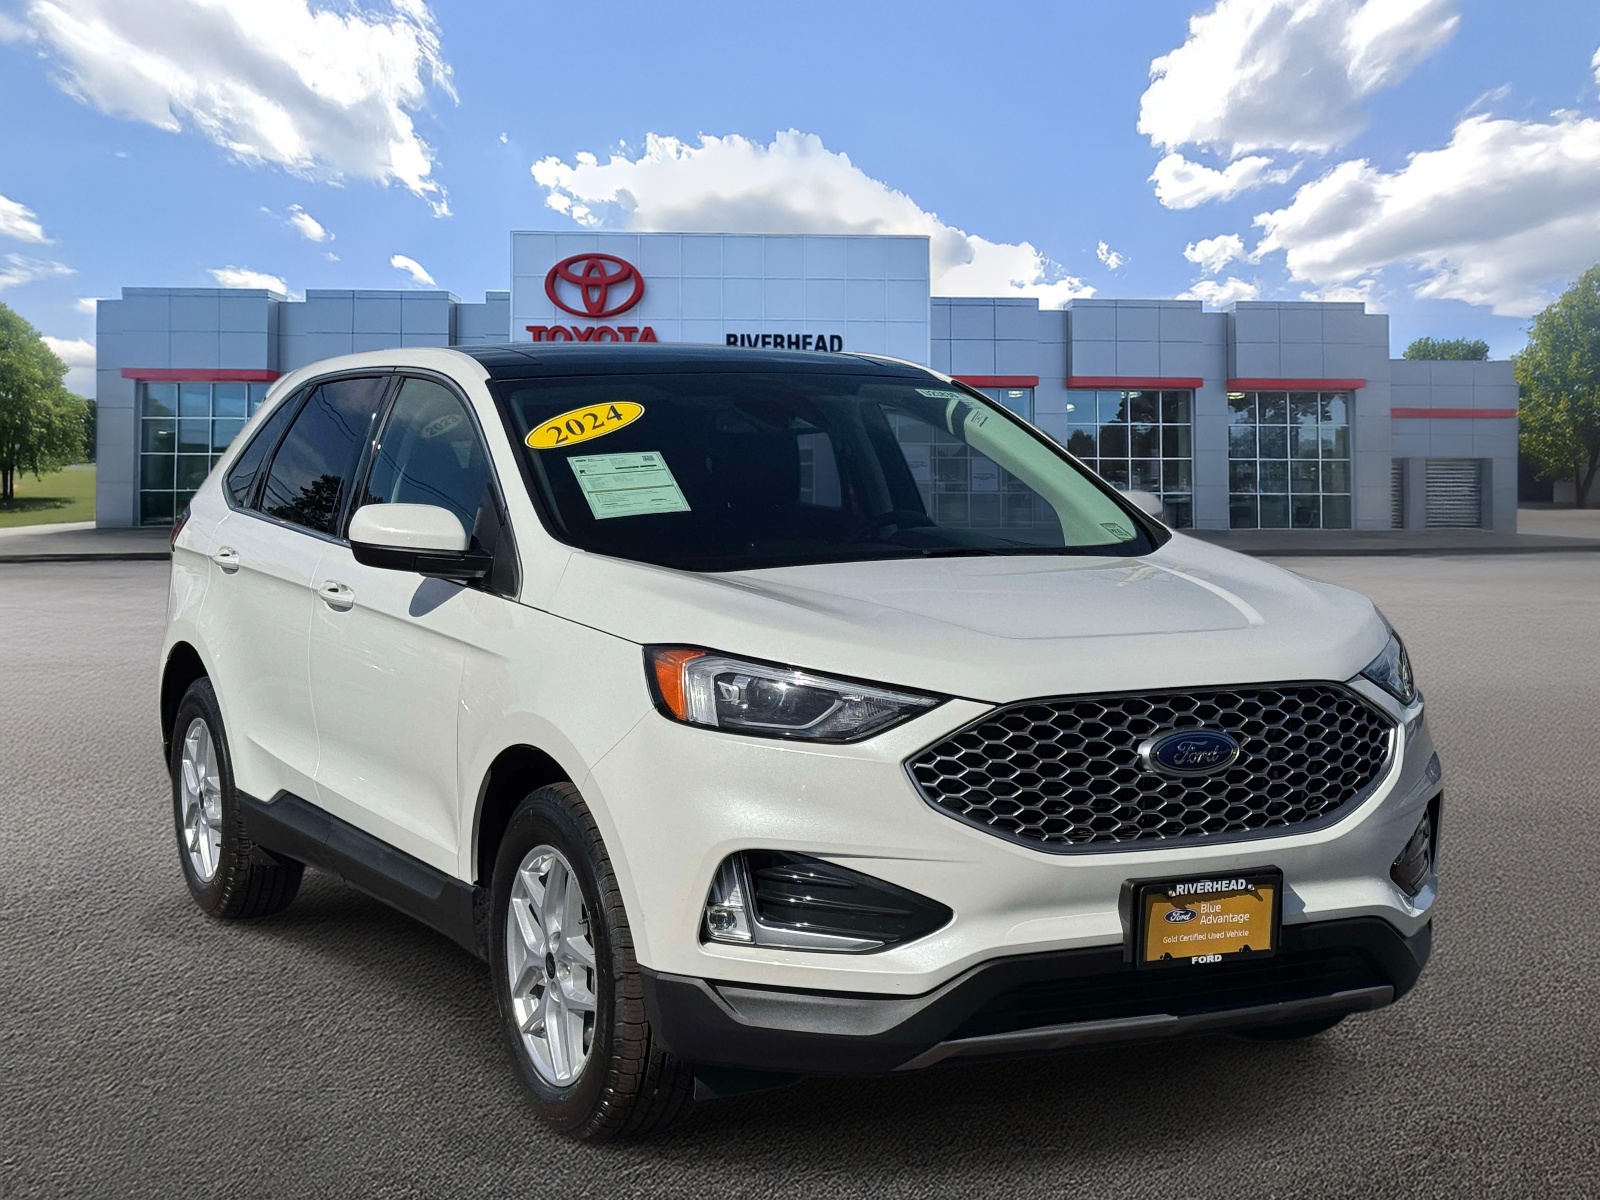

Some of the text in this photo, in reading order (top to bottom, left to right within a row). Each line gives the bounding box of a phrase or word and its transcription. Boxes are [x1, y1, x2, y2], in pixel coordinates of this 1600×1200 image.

[525, 325, 659, 343] TOYOTA
[726, 333, 844, 353] RIVERHEAD
[546, 404, 623, 445] 2024
[1173, 741, 1220, 765] Ford
[1176, 879, 1246, 896] RIVERHEAD
[1201, 903, 1222, 913] Blue
[1170, 910, 1192, 922] Ford
[1200, 913, 1250, 925] Advantage
[1163, 930, 1249, 943] Gold Certified Used Vehicle
[1191, 954, 1223, 965] FORD
